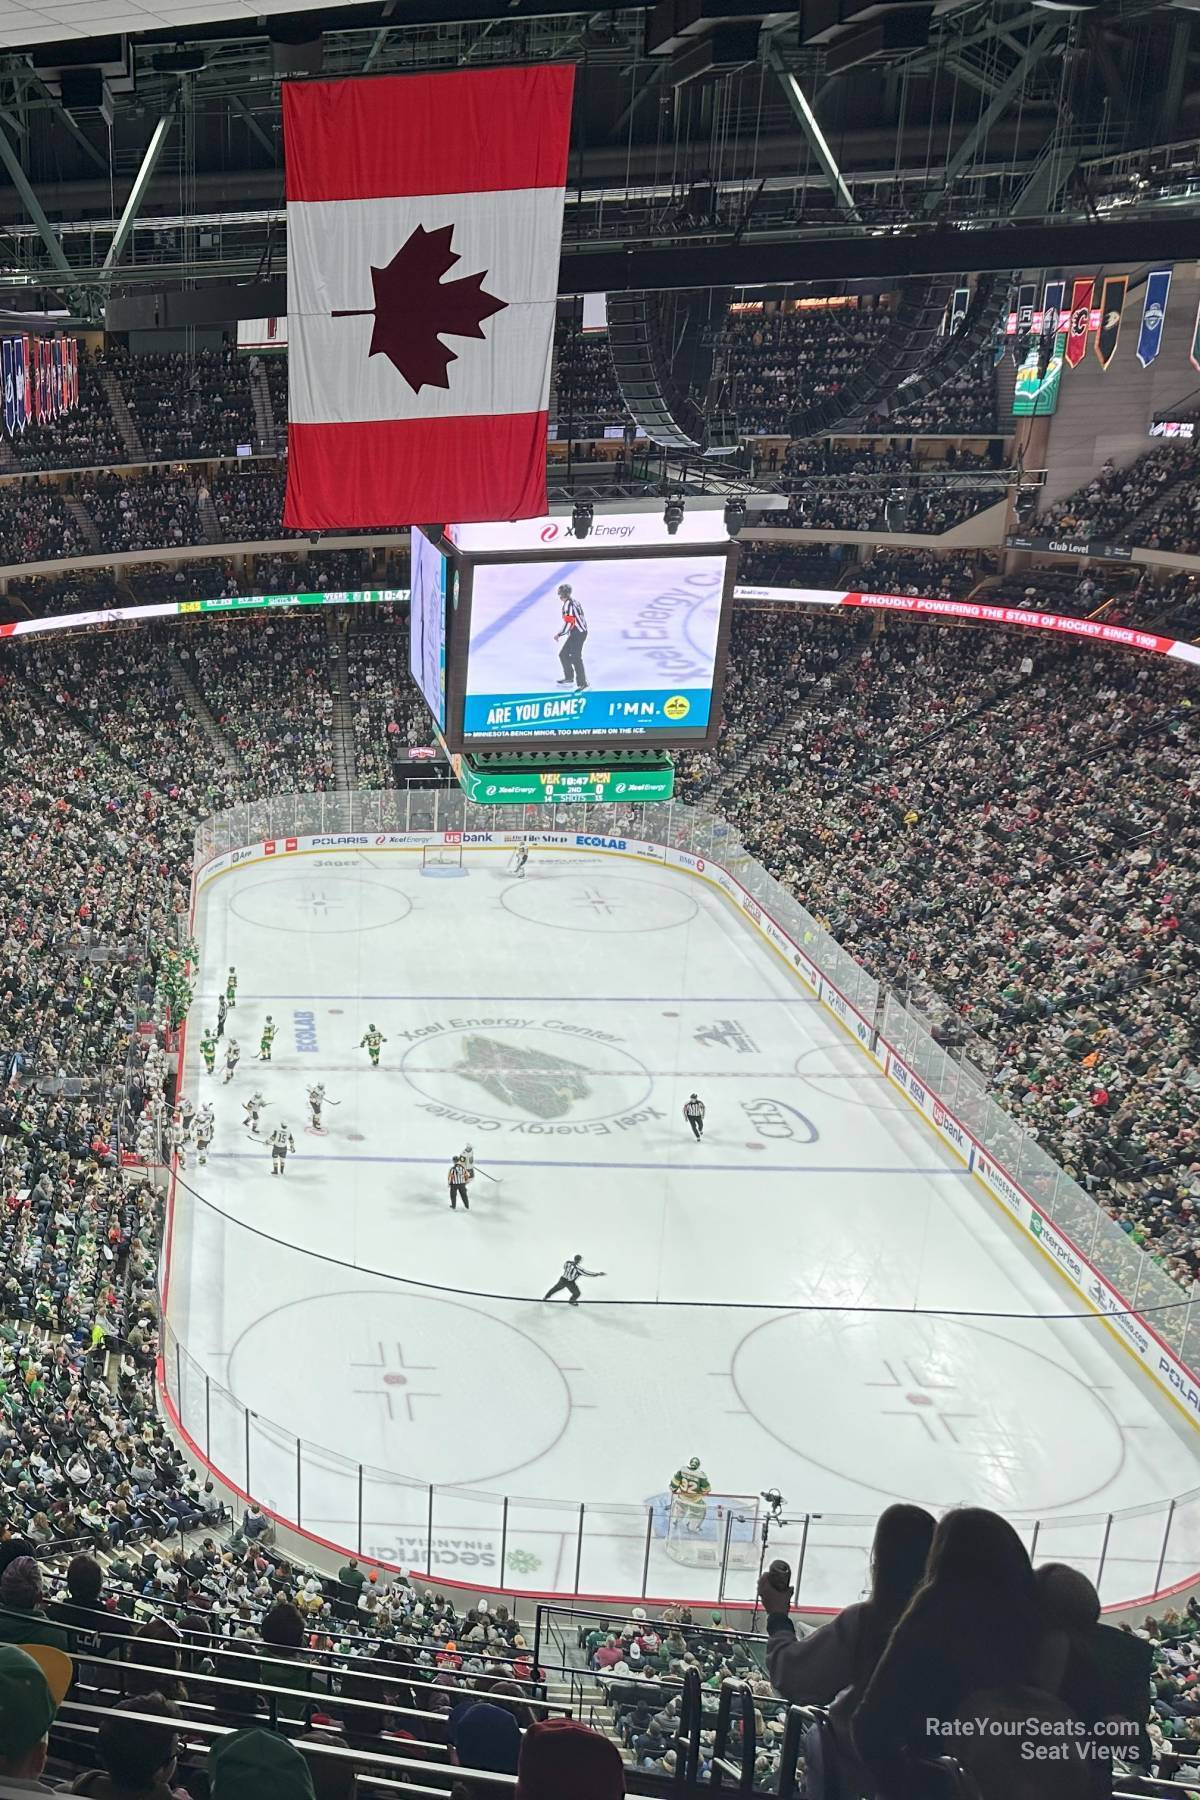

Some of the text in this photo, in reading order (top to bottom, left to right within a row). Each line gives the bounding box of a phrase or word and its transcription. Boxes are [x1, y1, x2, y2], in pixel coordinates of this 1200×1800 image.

[595, 525, 635, 536] Energy
[1049, 541, 1089, 554] Club Level
[377, 589, 411, 601] 10:47
[861, 595, 914, 608] PROUDLY
[917, 601, 979, 616] POWERING
[982, 607, 1003, 618] THE
[1006, 611, 1039, 624] STATE
[1041, 616, 1056, 625] OF
[1058, 618, 1101, 635] HOCKEY
[1103, 628, 1134, 642] SINCE
[487, 698, 587, 725] ARE YOU GAME?
[545, 784, 553, 795] 0
[596, 784, 603, 794] 0
[312, 836, 368, 846] POLARIS
[406, 836, 431, 844] Energy
[445, 832, 493, 843] us bank
[576, 835, 627, 850] ECOLAB
[293, 1010, 320, 1053] ECOLAB
[397, 1018, 629, 1044] Xcel Energy Center
[414, 1101, 667, 1136] Xcel Energy Center
[740, 1101, 795, 1139] CHS
[277, 1132, 288, 1144] 15
[943, 1114, 964, 1147] bank
[990, 1170, 1021, 1207] ANDERSEN
[1032, 1217, 1082, 1276] enterprise
[680, 1478, 698, 1494] 32
[395, 1536, 493, 1550] FINANCIAL
